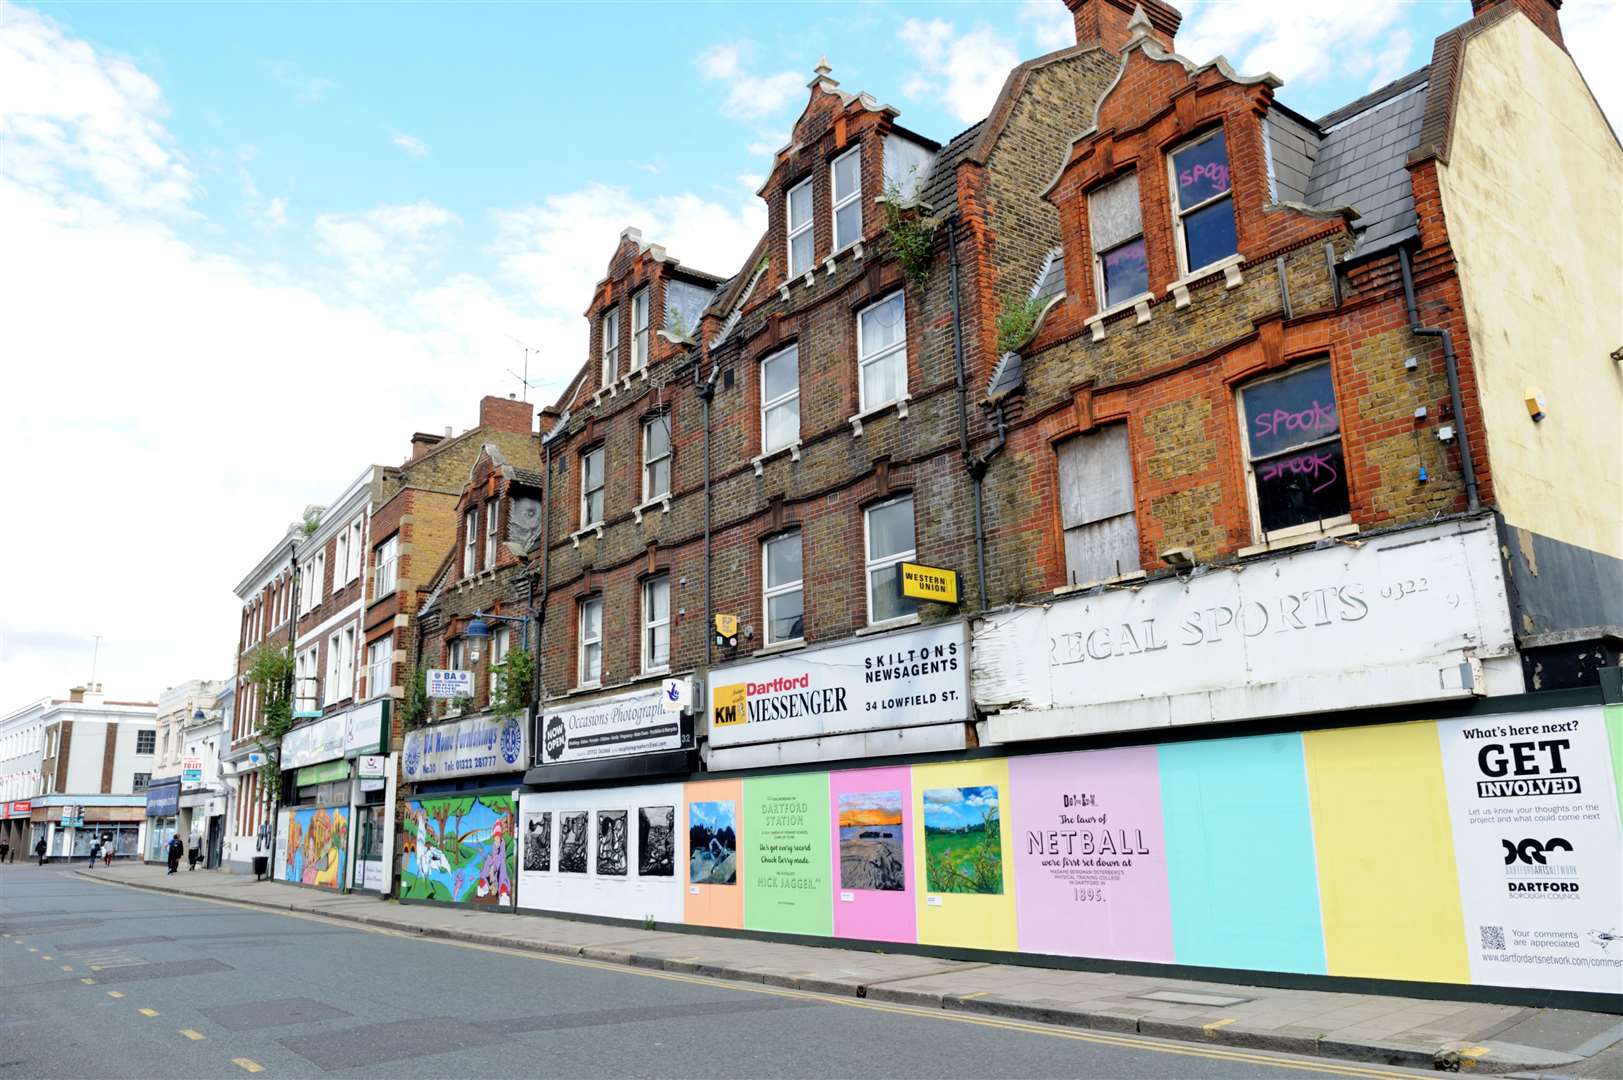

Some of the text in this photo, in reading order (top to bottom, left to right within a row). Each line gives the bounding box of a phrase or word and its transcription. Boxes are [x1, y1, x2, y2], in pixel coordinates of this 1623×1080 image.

[905, 572, 946, 585] WESTERN
[919, 582, 946, 593] UNION
[1181, 583, 1369, 646] SPORTS
[865, 642, 957, 669] SKILTONS
[444, 672, 457, 680] BA
[865, 657, 958, 683] NEWSAGENTS
[747, 673, 808, 696] Dartford
[747, 687, 848, 723] MESSENGER
[865, 690, 959, 711] 34 LOWFIELD ST.
[568, 711, 609, 730] Occasions
[715, 705, 737, 724] KM
[547, 724, 564, 740] NOW
[1463, 720, 1579, 739] What's here next?
[547, 735, 565, 751] OPEN
[681, 734, 691, 743] 32
[1478, 739, 1571, 777] GET
[1480, 778, 1578, 797] INVOLVED
[761, 802, 809, 814] DARTFORD
[1494, 807, 1514, 815] know
[1516, 807, 1532, 816] your
[1535, 805, 1570, 814] thoughts
[1585, 803, 1599, 811] the
[765, 815, 804, 826] STATION
[1058, 813, 1107, 825] The laws of
[1470, 815, 1495, 824] project
[1497, 815, 1512, 823] and
[1513, 815, 1532, 823] what
[1582, 812, 1600, 820] next
[1026, 829, 1149, 855] NETBALL
[778, 855, 793, 866] Berry
[1041, 857, 1132, 868] were first set down at
[1074, 887, 1107, 902] 1895.
[1508, 882, 1580, 892] DARTFORD
[1511, 929, 1579, 939] Your comments
[1530, 939, 1580, 949] appreciated
